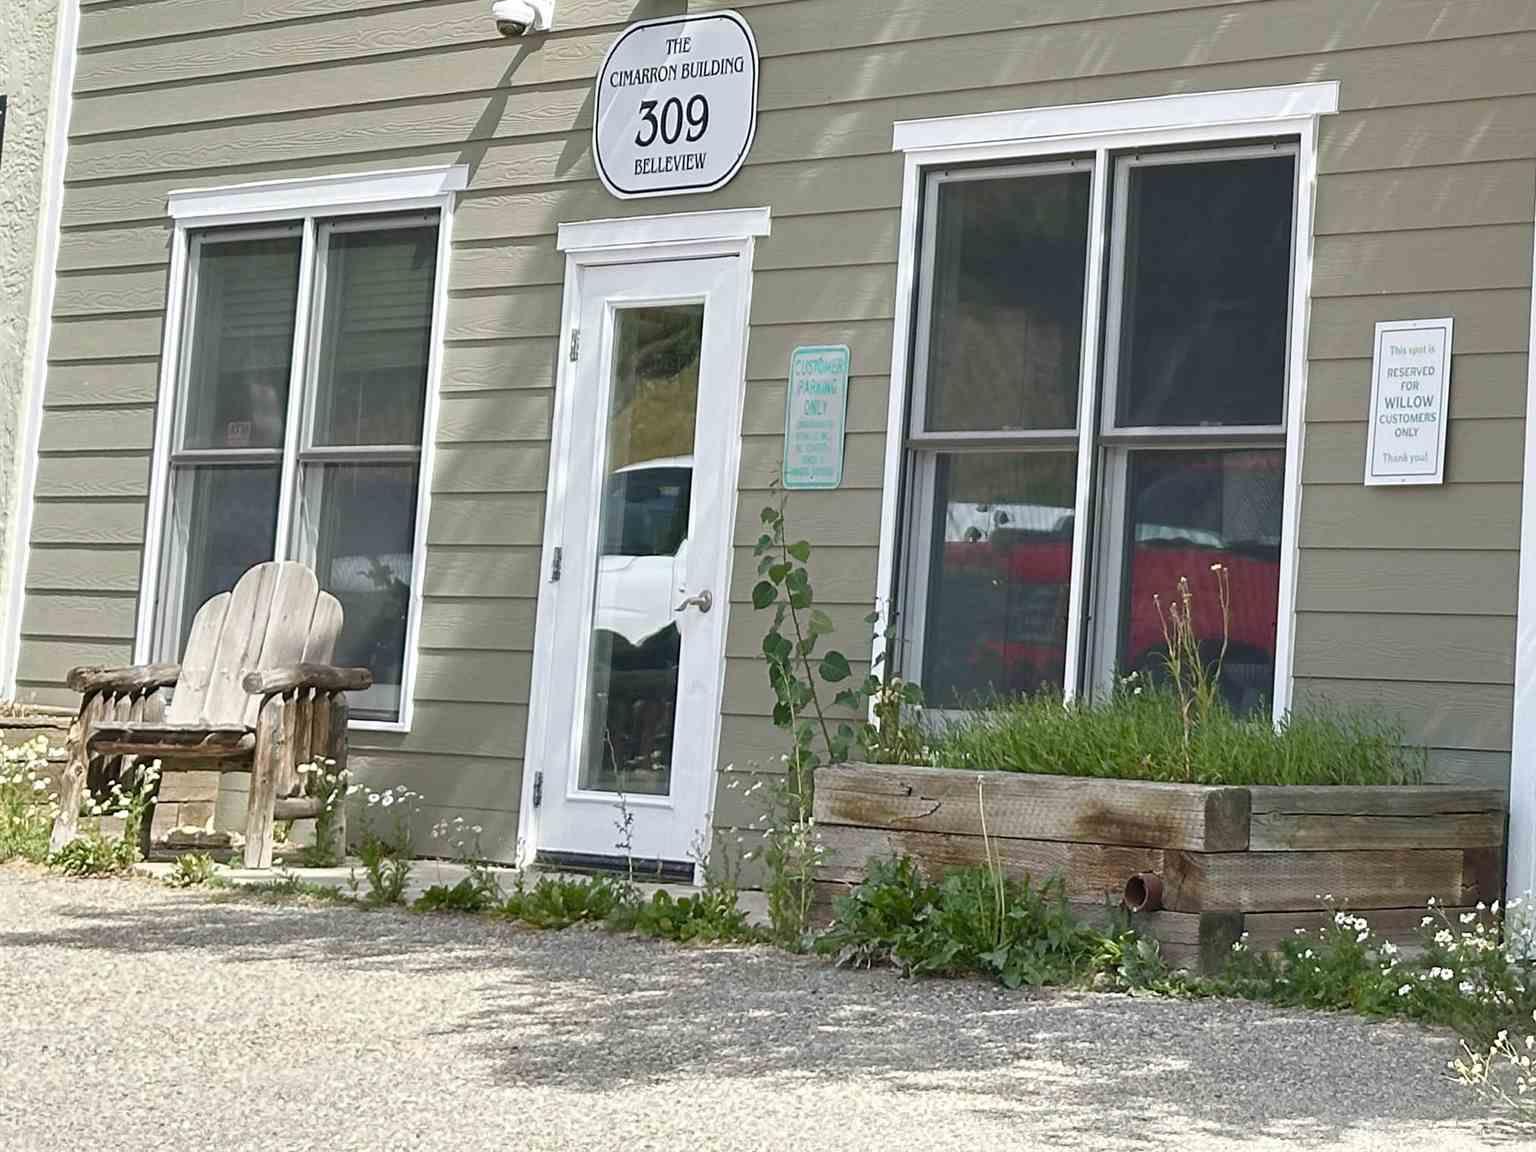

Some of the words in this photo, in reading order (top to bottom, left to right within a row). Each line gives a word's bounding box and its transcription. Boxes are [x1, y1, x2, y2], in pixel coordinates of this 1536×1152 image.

[666, 37, 691, 55] THE
[610, 63, 678, 88] CIMARRON
[681, 56, 744, 80] BUILDING
[634, 94, 709, 147] 309
[634, 152, 707, 176] BELLEVIEW
[1390, 345, 1407, 357] This
[1387, 366, 1435, 378] RESERVED
[1400, 381, 1420, 392] FOR
[1384, 395, 1434, 409] WILLOW
[1379, 412, 1437, 425] CUSTOMERS
[1394, 427, 1420, 438] ONLY
[1383, 452, 1408, 465] Thank
